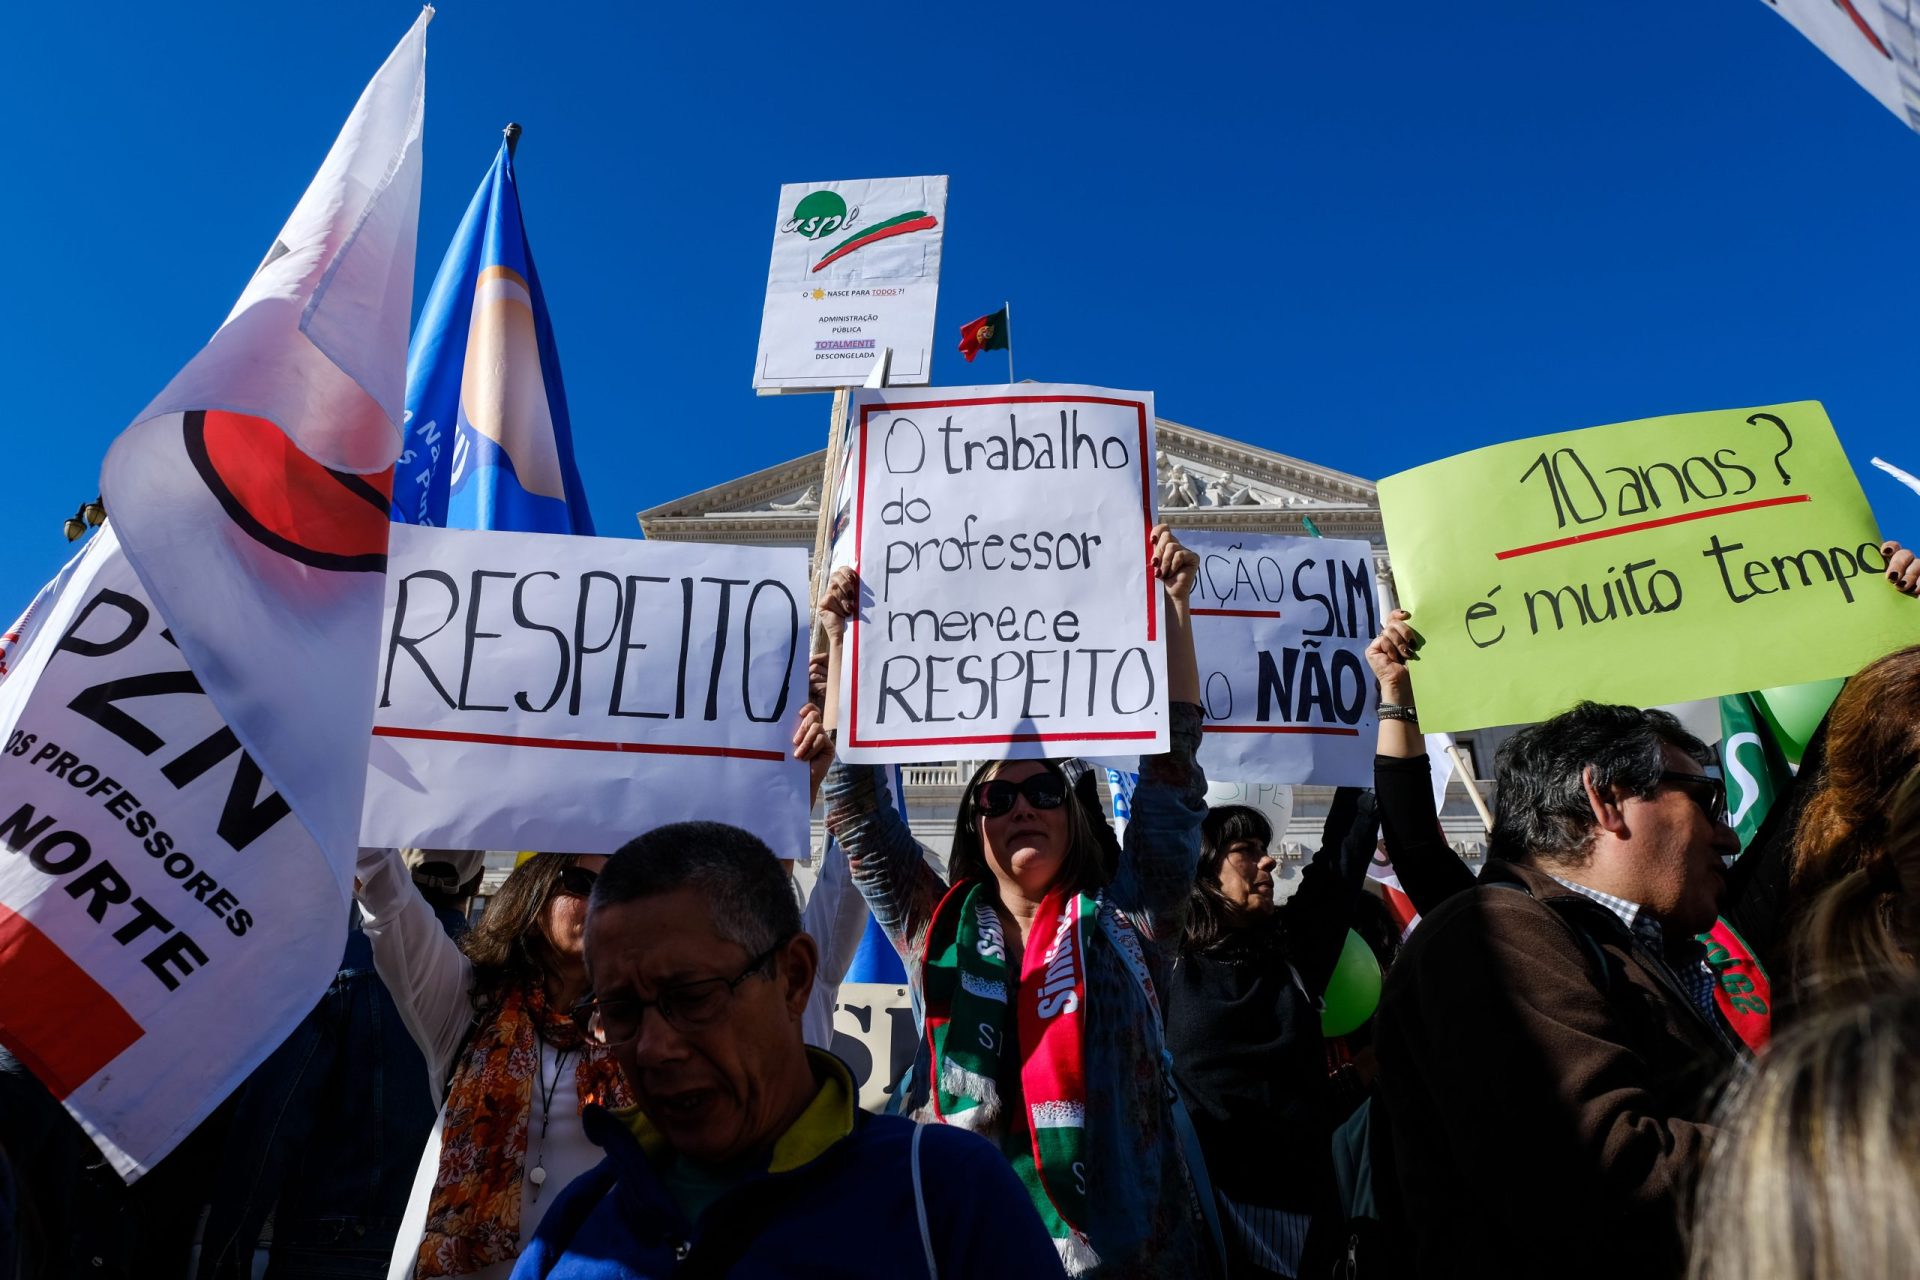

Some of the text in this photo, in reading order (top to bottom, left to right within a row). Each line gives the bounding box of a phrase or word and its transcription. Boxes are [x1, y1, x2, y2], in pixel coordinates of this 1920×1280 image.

[818, 313, 879, 324] ADMINISTRAÇÃO
[827, 289, 850, 298] NASCE
[851, 289, 871, 297] PARA
[871, 288, 898, 297] TODOS
[814, 339, 876, 350] TOTALMENTE
[815, 352, 875, 360] DESCONGELADA
[832, 325, 862, 334] PÚBLICA
[884, 409, 1129, 475] O trabalho
[881, 487, 931, 526] do
[1520, 447, 1608, 529] 10
[884, 514, 1102, 602] professor
[887, 606, 1080, 643] merece
[1292, 558, 1376, 639] SIM
[1465, 534, 1889, 649] é muito tempo
[379, 569, 799, 723] RESPEITO
[29, 742, 254, 938] PROFESSORES
[0, 803, 211, 992] NORTE
